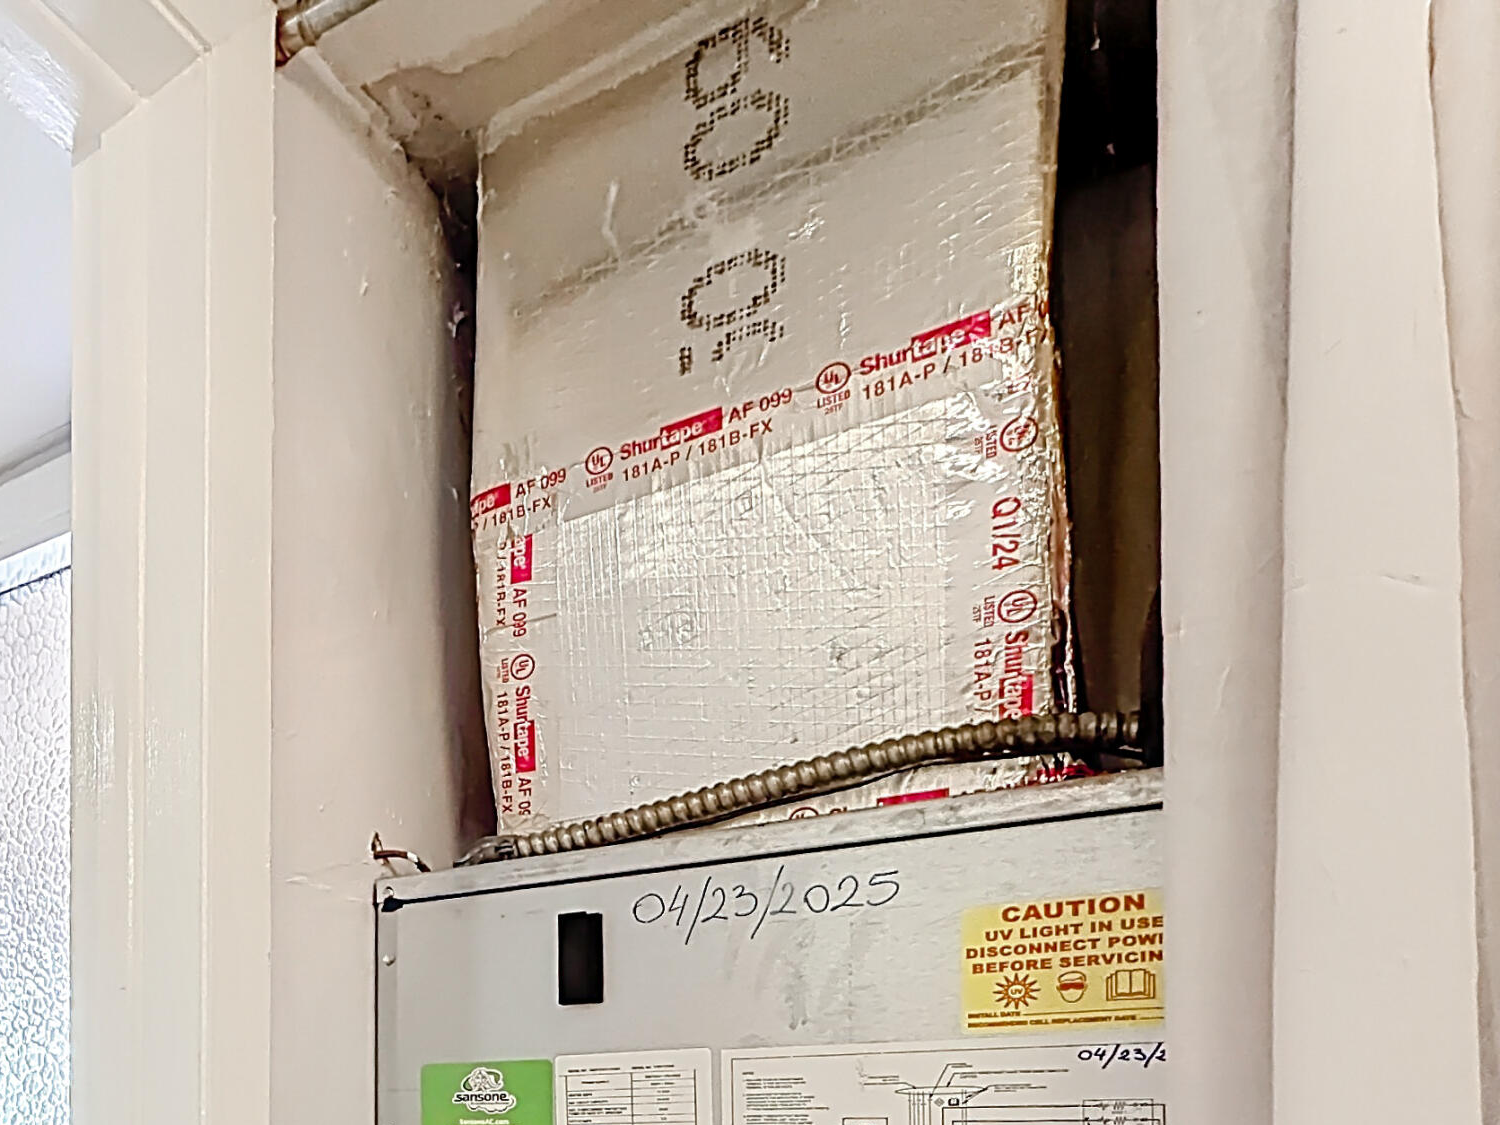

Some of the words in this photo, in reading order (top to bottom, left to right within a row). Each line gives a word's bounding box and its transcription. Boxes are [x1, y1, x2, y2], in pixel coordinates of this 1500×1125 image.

[862, 363, 936, 400] 181A-P
[817, 388, 850, 408] LISTED
[619, 420, 703, 461] Shurtape
[728, 403, 754, 424] AF
[759, 388, 793, 411] 099
[622, 453, 680, 482] 181A-P
[698, 418, 773, 459] 181B-FX
[515, 478, 537, 498] AF
[540, 468, 567, 490] 099
[585, 472, 613, 488] LISTED
[991, 496, 1022, 571] Q1/24
[512, 588, 527, 608] AF
[983, 595, 997, 628] LISTED
[974, 638, 993, 703] 181A-P
[496, 691, 510, 742] 181A-P
[514, 685, 531, 758] Shurtape
[500, 756, 514, 814] 181B-FX
[518, 777, 532, 795] AF
[632, 865, 900, 945] 04/23/2025
[1001, 893, 1145, 922] CAUTION
[985, 929, 1013, 941] UV
[1019, 922, 1084, 938] LIGHT
[1090, 919, 1113, 933] IN
[1120, 916, 1164, 931] USE
[965, 938, 1101, 959] DISCONNECT
[1108, 932, 1163, 948] POW
[972, 957, 1053, 974] BEFORE
[453, 1092, 510, 1102] sansone
